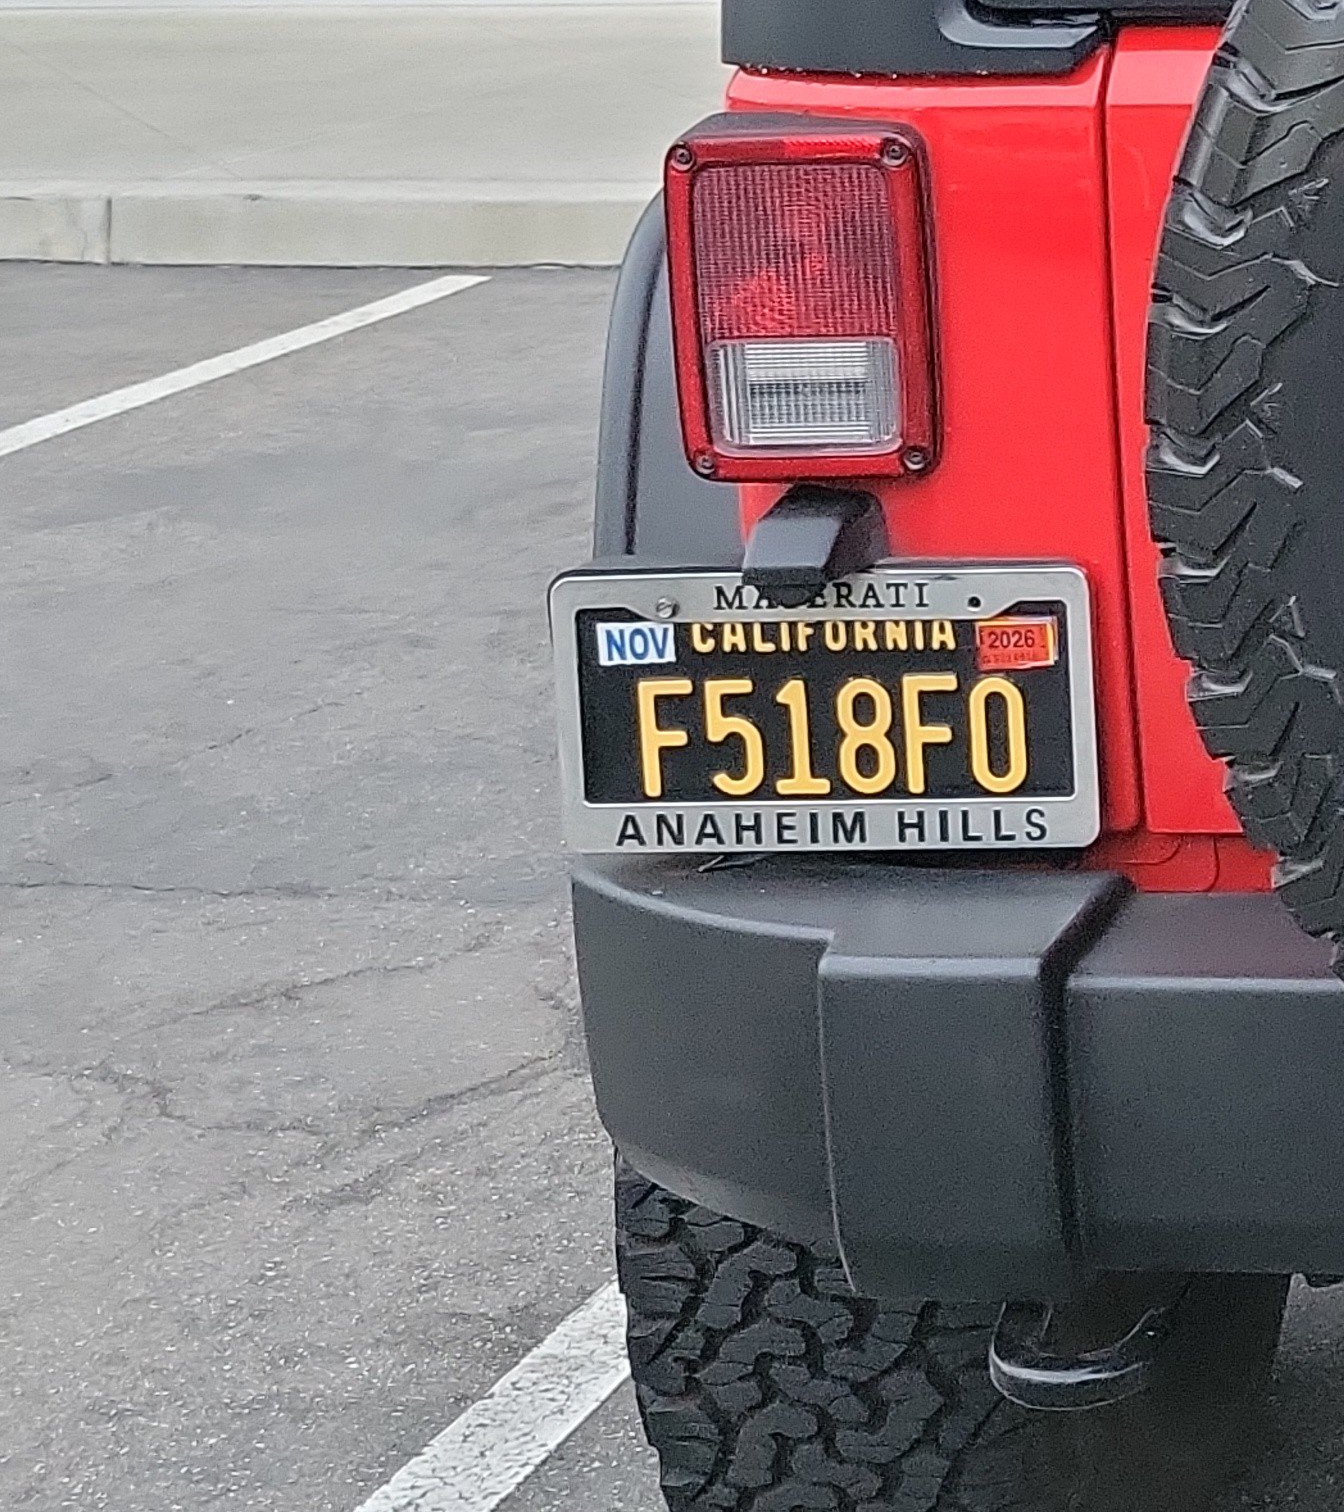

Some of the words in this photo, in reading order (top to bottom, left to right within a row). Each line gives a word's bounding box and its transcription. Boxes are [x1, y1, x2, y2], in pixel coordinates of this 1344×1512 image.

[713, 582, 930, 610] MAERATI
[605, 627, 672, 661] NOV
[690, 619, 957, 655] CALIFORNIA
[988, 629, 1035, 649] 2026
[615, 809, 868, 847] ANAHEIM
[898, 807, 1049, 843] HILLS
